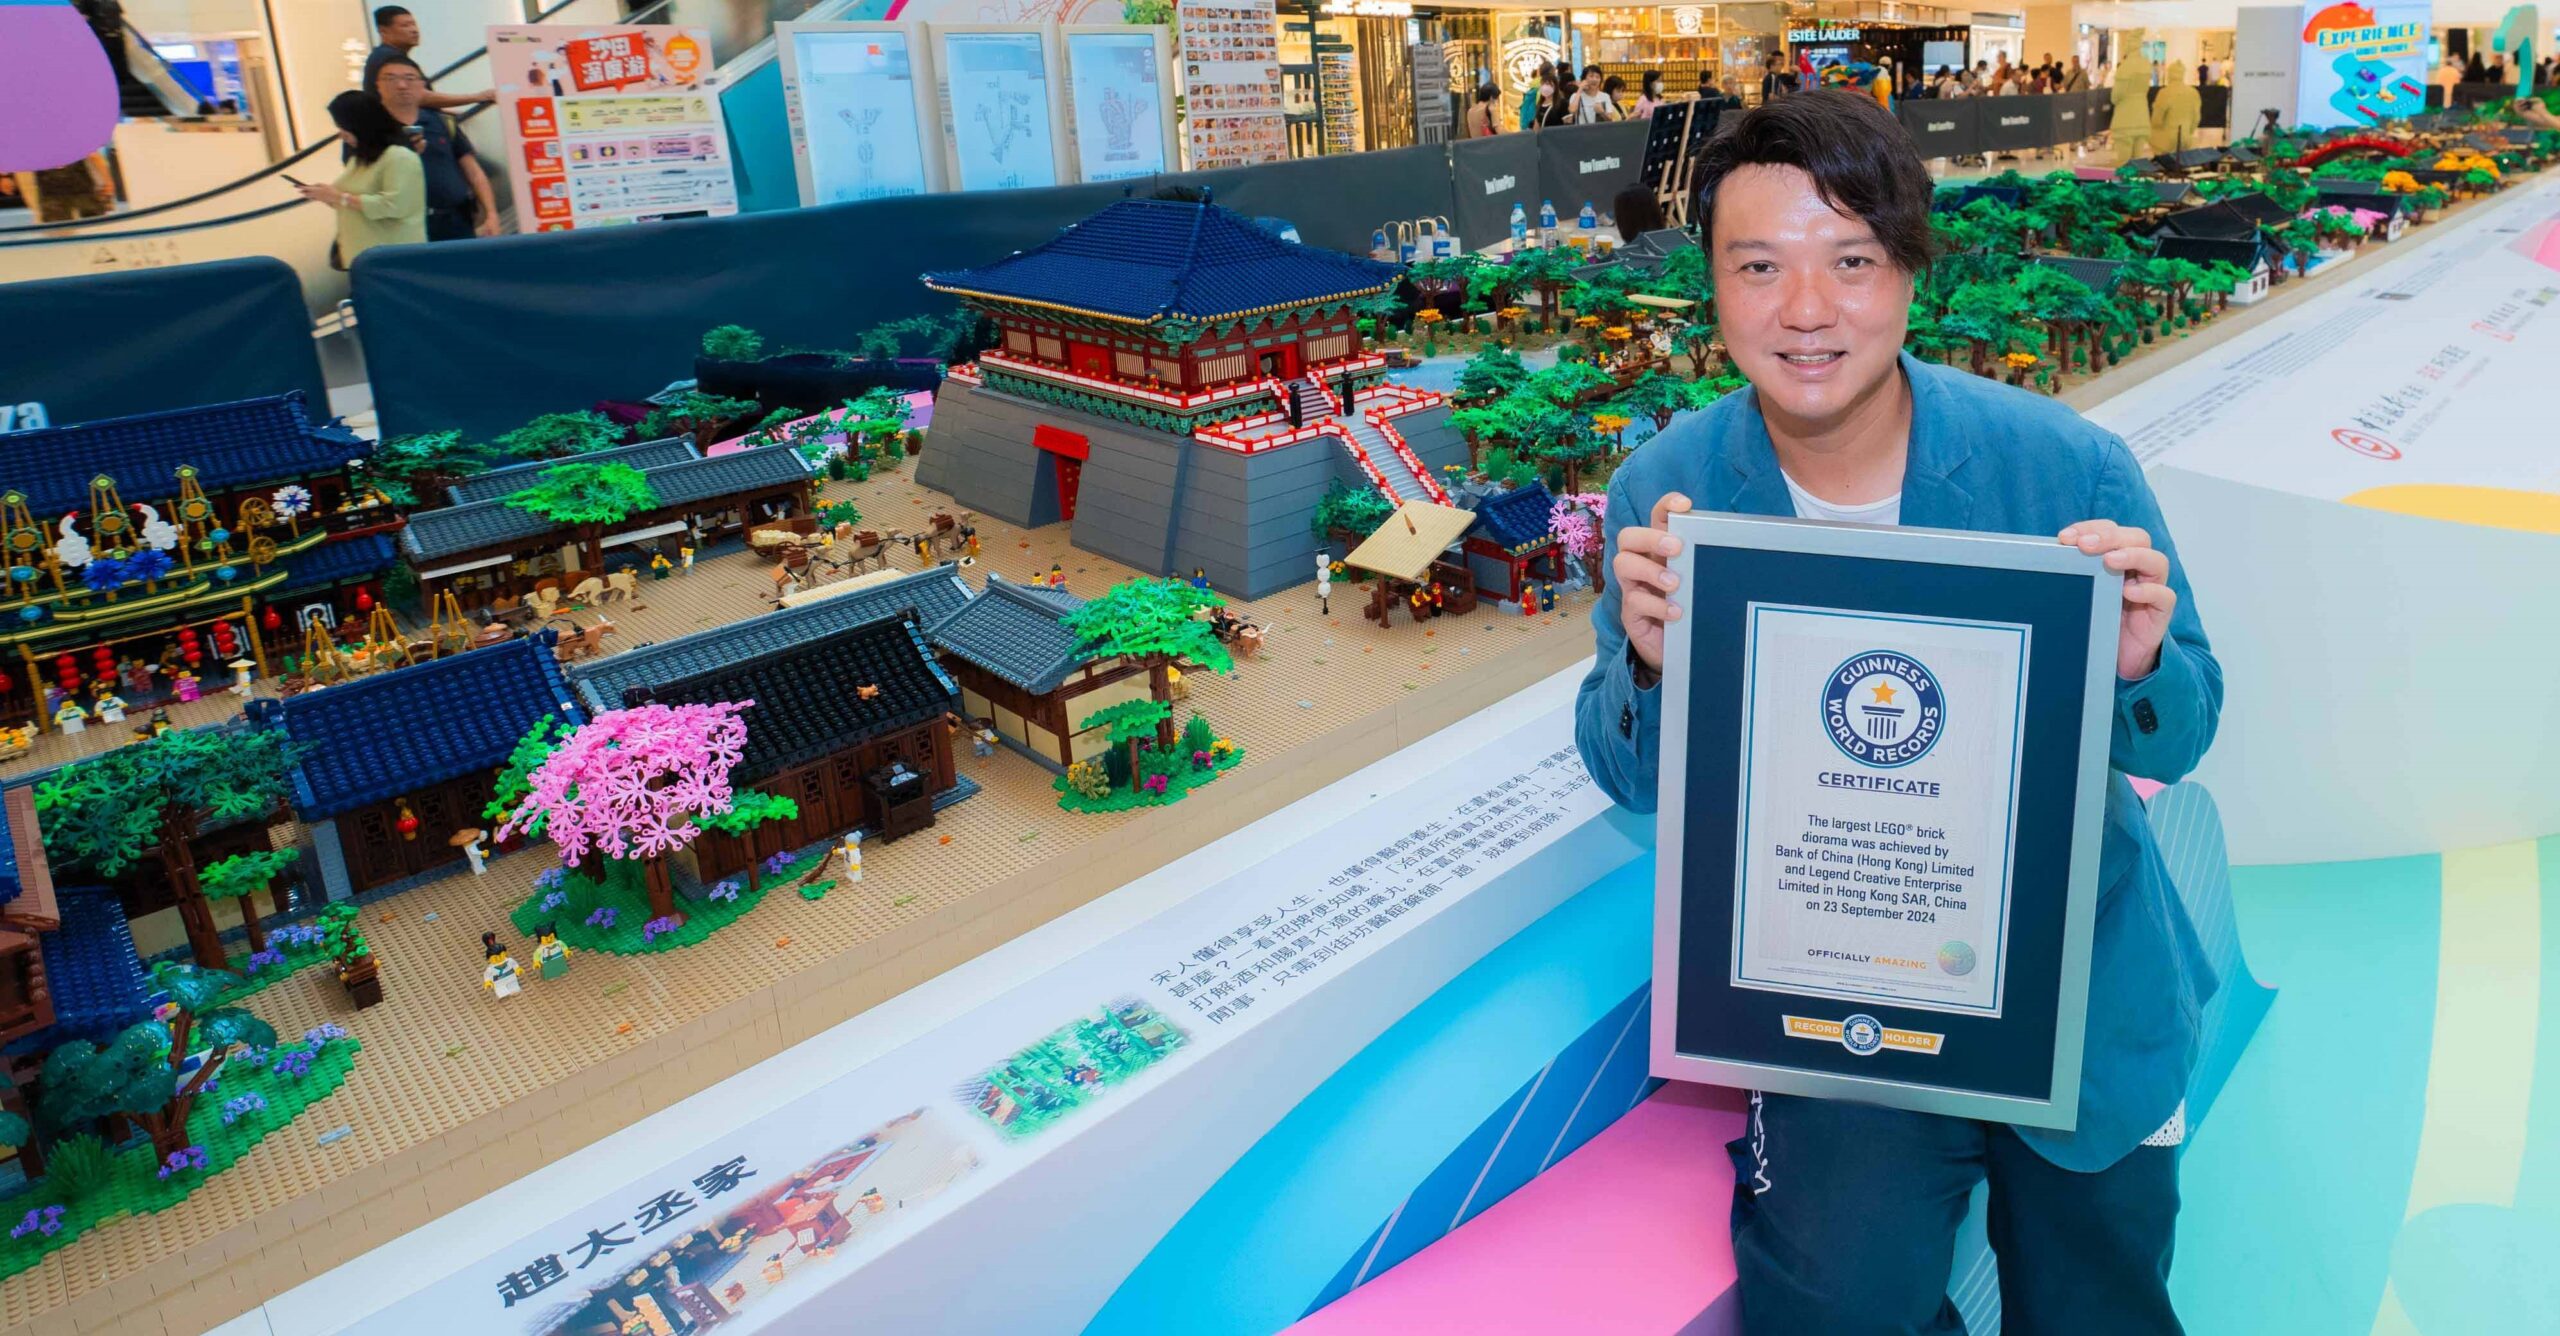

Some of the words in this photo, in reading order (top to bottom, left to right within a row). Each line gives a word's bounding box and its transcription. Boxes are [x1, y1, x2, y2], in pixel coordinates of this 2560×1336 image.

[1818, 28, 1860, 41] LAUDER
[1840, 657, 1931, 693] GUINNESS
[1828, 698, 1867, 756] WORLD
[1872, 706, 1938, 762] RECORDS
[1818, 771, 1940, 796] CERTIFICATE
[1808, 814, 1829, 828] The
[1832, 817, 1871, 832] largest
[1917, 826, 1945, 840] brick
[1801, 831, 1848, 847] diorama
[1851, 838, 1876, 850] was
[1879, 841, 1931, 855] achieved
[1935, 844, 1949, 860] by
[1775, 844, 1804, 859] Bank
[1807, 849, 1819, 861] of
[1821, 850, 1853, 864] China
[1857, 853, 1891, 871] (Hong
[1895, 858, 1928, 874] Kong)
[1931, 861, 1974, 877] Limited
[1785, 864, 1806, 876] and
[1809, 865, 1850, 881] Legend
[1853, 870, 1900, 886] Creative
[1904, 876, 1962, 893] Enterprise
[1778, 879, 1819, 894] Limited
[1823, 884, 1833, 896] in
[1837, 885, 1866, 902] Hong
[1870, 889, 1898, 905] Kong
[1902, 892, 1930, 908] SAR,
[1935, 895, 1967, 910] China
[1806, 901, 1820, 911] on
[1823, 900, 1838, 912] 23
[1841, 902, 1904, 920] September
[1907, 910, 1935, 923] 2024
[1807, 949, 1870, 963] OFFICIALLY
[1874, 956, 1927, 970] AMAZING
[1793, 1021, 1840, 1034] RECORD
[1885, 1033, 1931, 1046] HOLDER
[1849, 1018, 1877, 1030] GUINNESS
[496, 1154, 758, 1308] 趙太丞家
